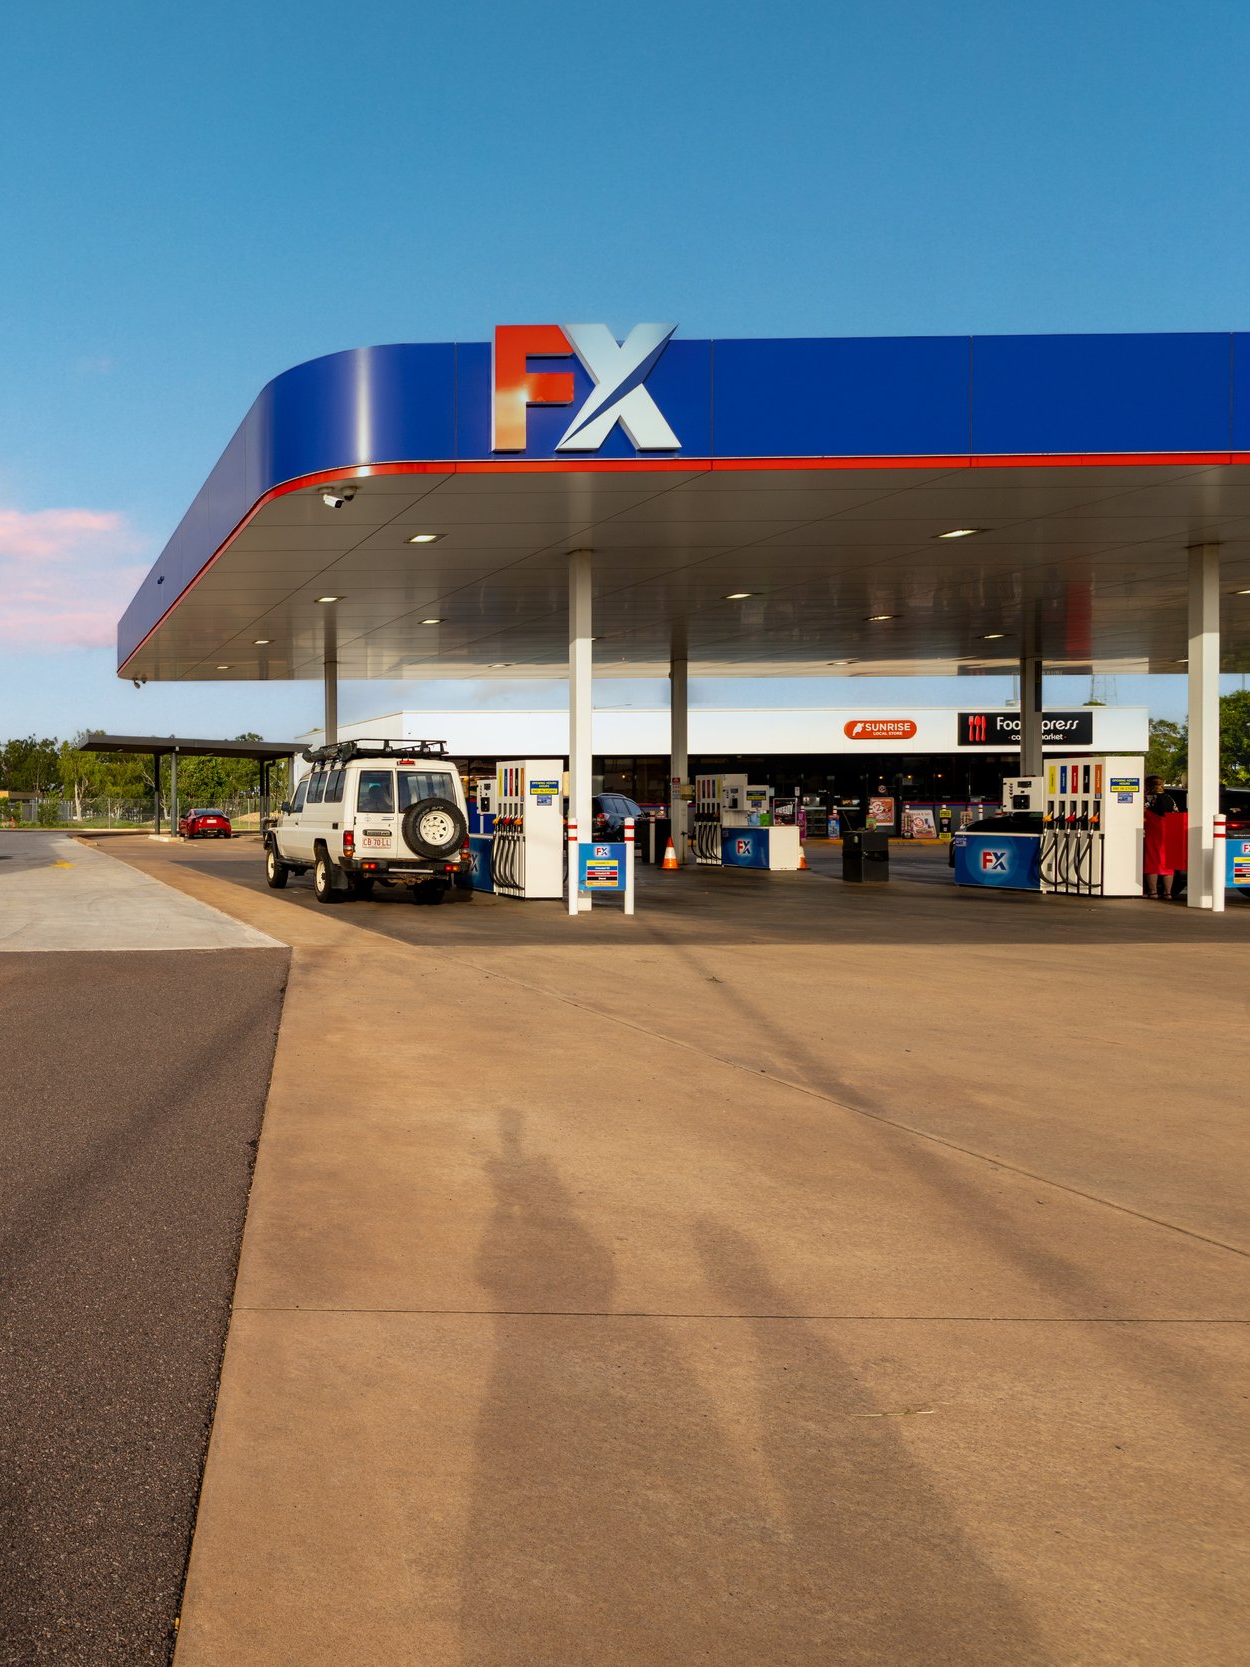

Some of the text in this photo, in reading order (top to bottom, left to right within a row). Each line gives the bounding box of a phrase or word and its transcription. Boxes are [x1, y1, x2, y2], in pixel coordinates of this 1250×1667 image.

[492, 323, 682, 452] FX
[865, 722, 911, 731] SUNRISE
[596, 847, 608, 856] FX
[736, 839, 751, 855] FX
[1243, 844, 1250, 853] F
[982, 851, 1007, 871] FX
